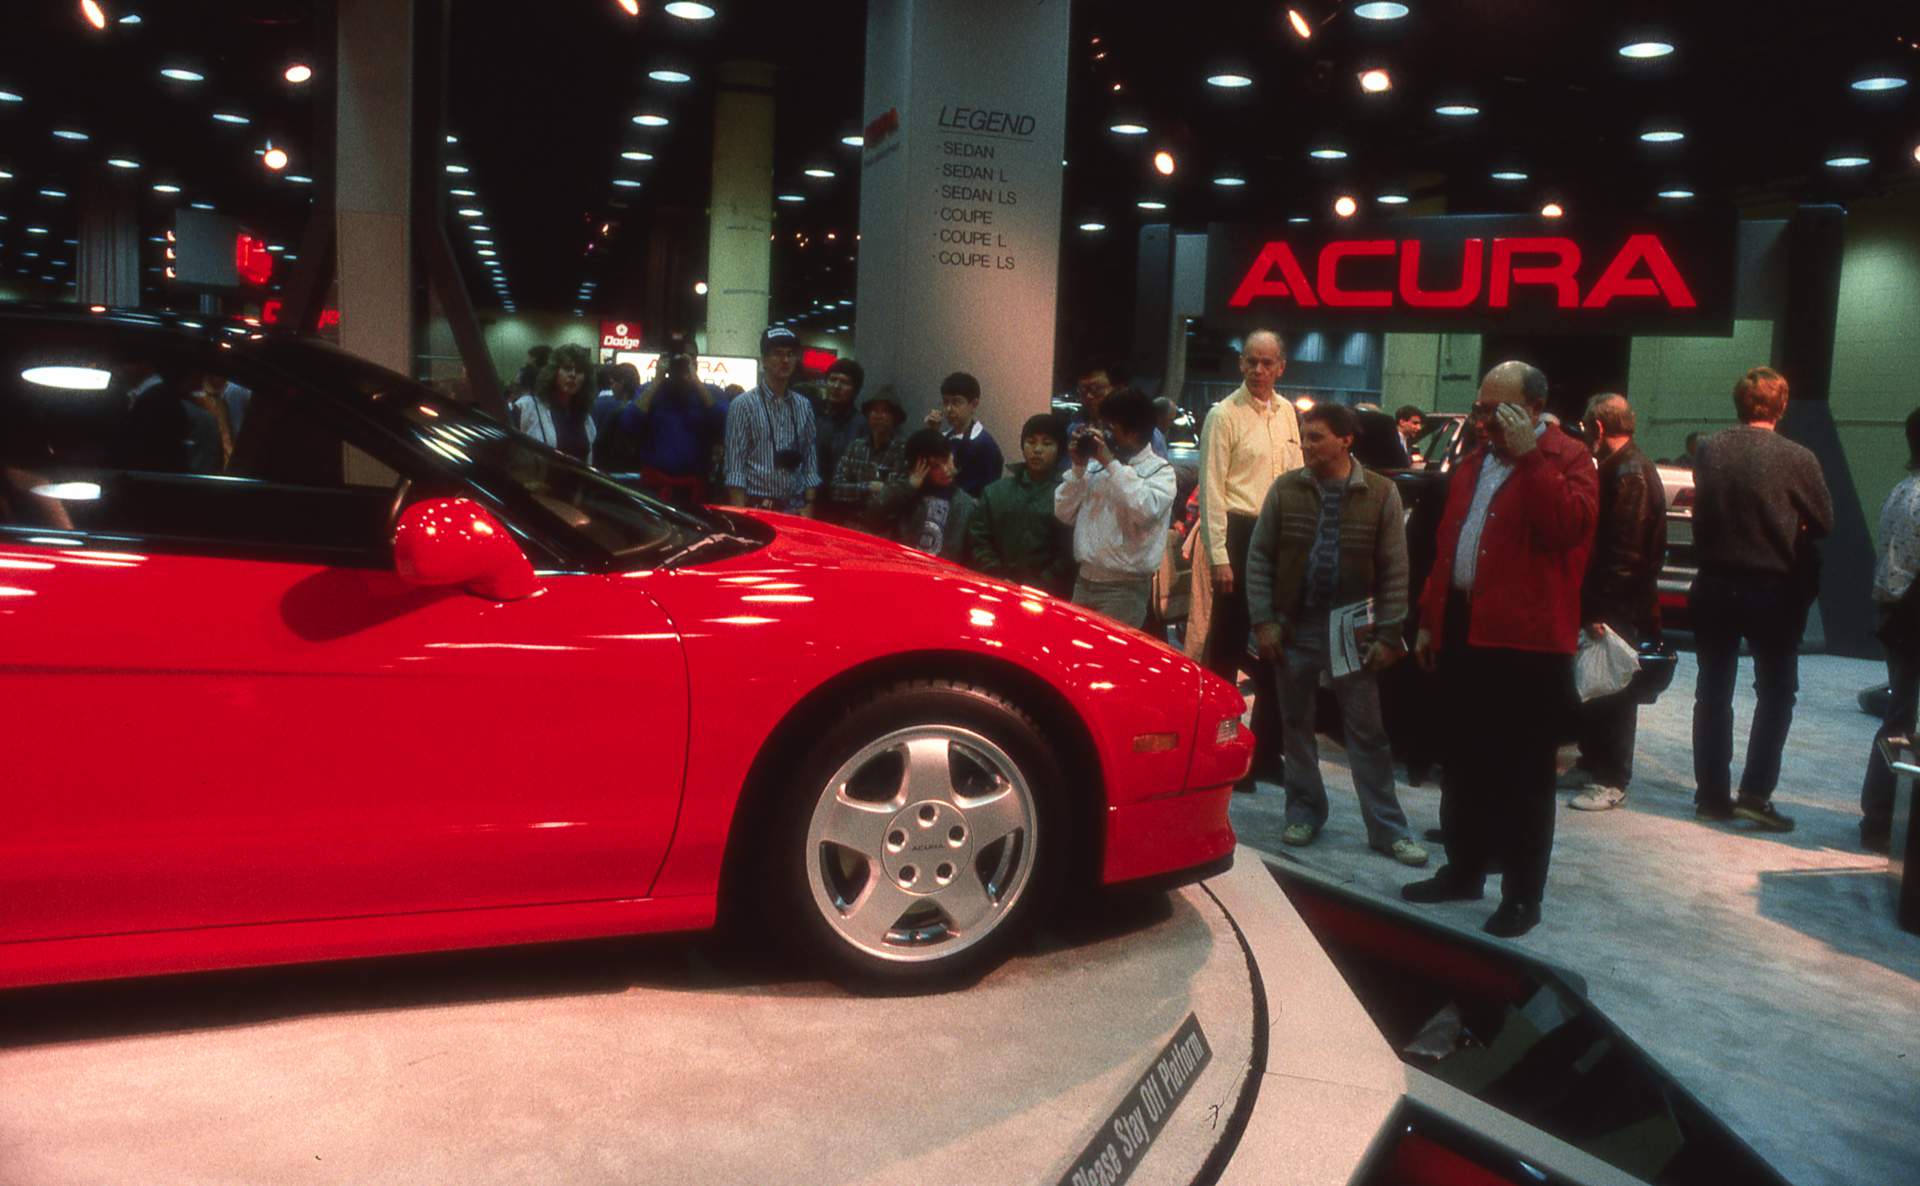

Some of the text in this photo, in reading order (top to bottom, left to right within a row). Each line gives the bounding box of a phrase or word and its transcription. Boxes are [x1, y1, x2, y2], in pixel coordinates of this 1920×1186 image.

[938, 106, 1036, 135] LEGEND
[943, 141, 994, 159] SEDAN
[942, 163, 1009, 182] SEDAN L
[941, 184, 1017, 205] SEDAN LS
[940, 207, 992, 225] COUPE
[939, 229, 1007, 248] COUPE L
[938, 251, 1016, 270] COUPE LS
[1229, 234, 1698, 309] ACURA
[603, 335, 640, 349] Dodge
[647, 359, 728, 373] ARA
[1113, 1105, 1150, 1159] Stay
[1139, 1074, 1167, 1122] Off
[1156, 1031, 1205, 1099] Platform
